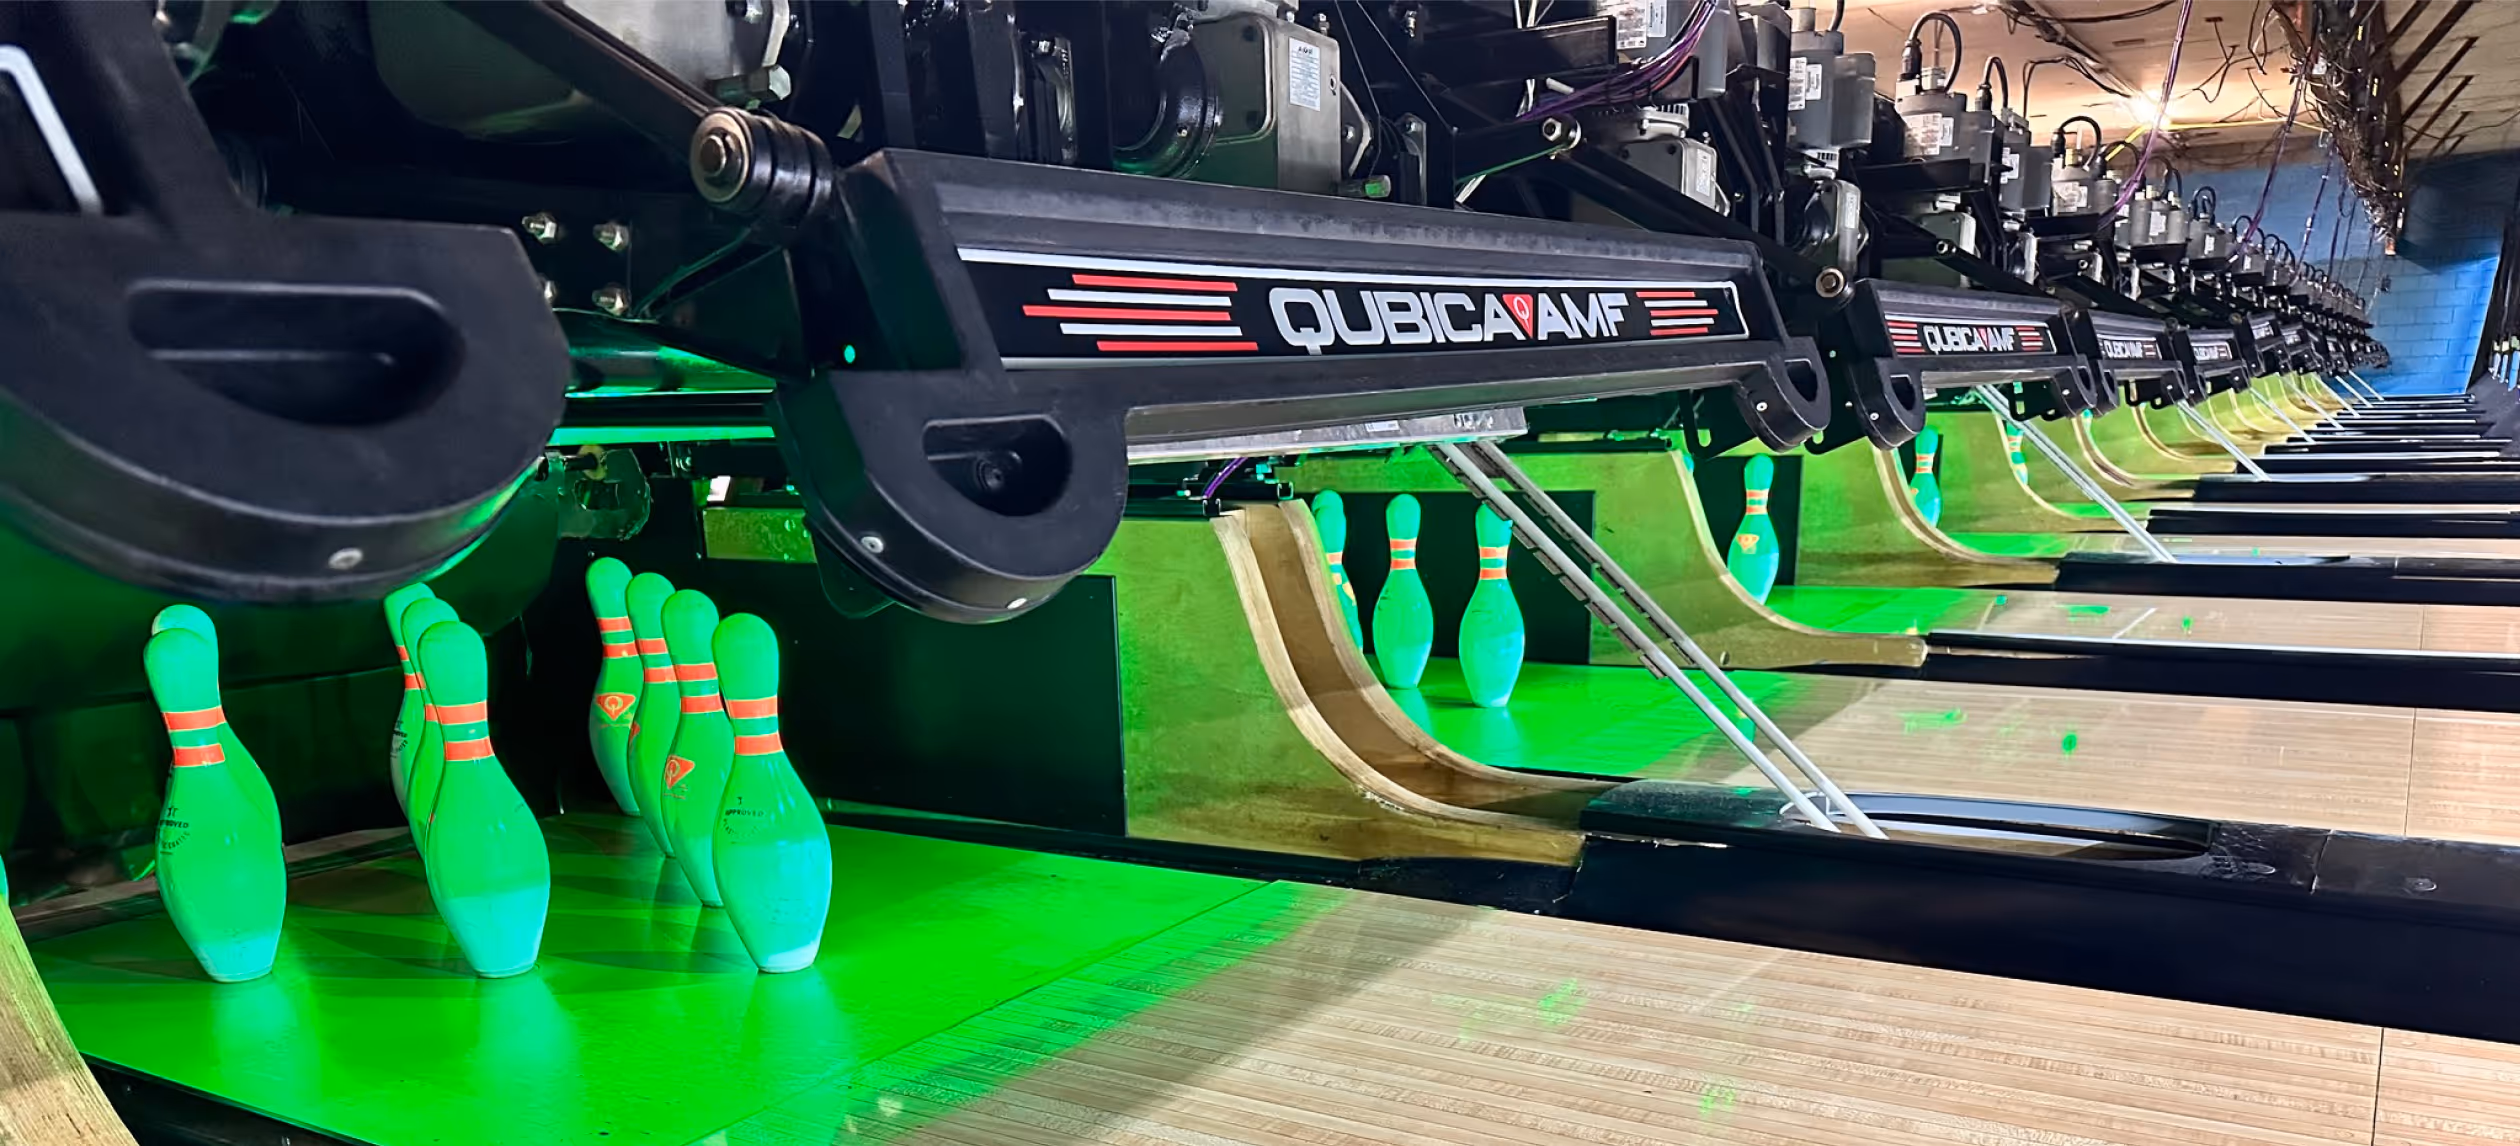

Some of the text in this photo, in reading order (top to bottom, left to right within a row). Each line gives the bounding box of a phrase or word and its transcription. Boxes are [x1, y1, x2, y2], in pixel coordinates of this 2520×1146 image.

[1269, 287, 1525, 355] QUBICA
[1537, 292, 1630, 341] AMF
[1923, 325, 2015, 355] QUBICA AMF
